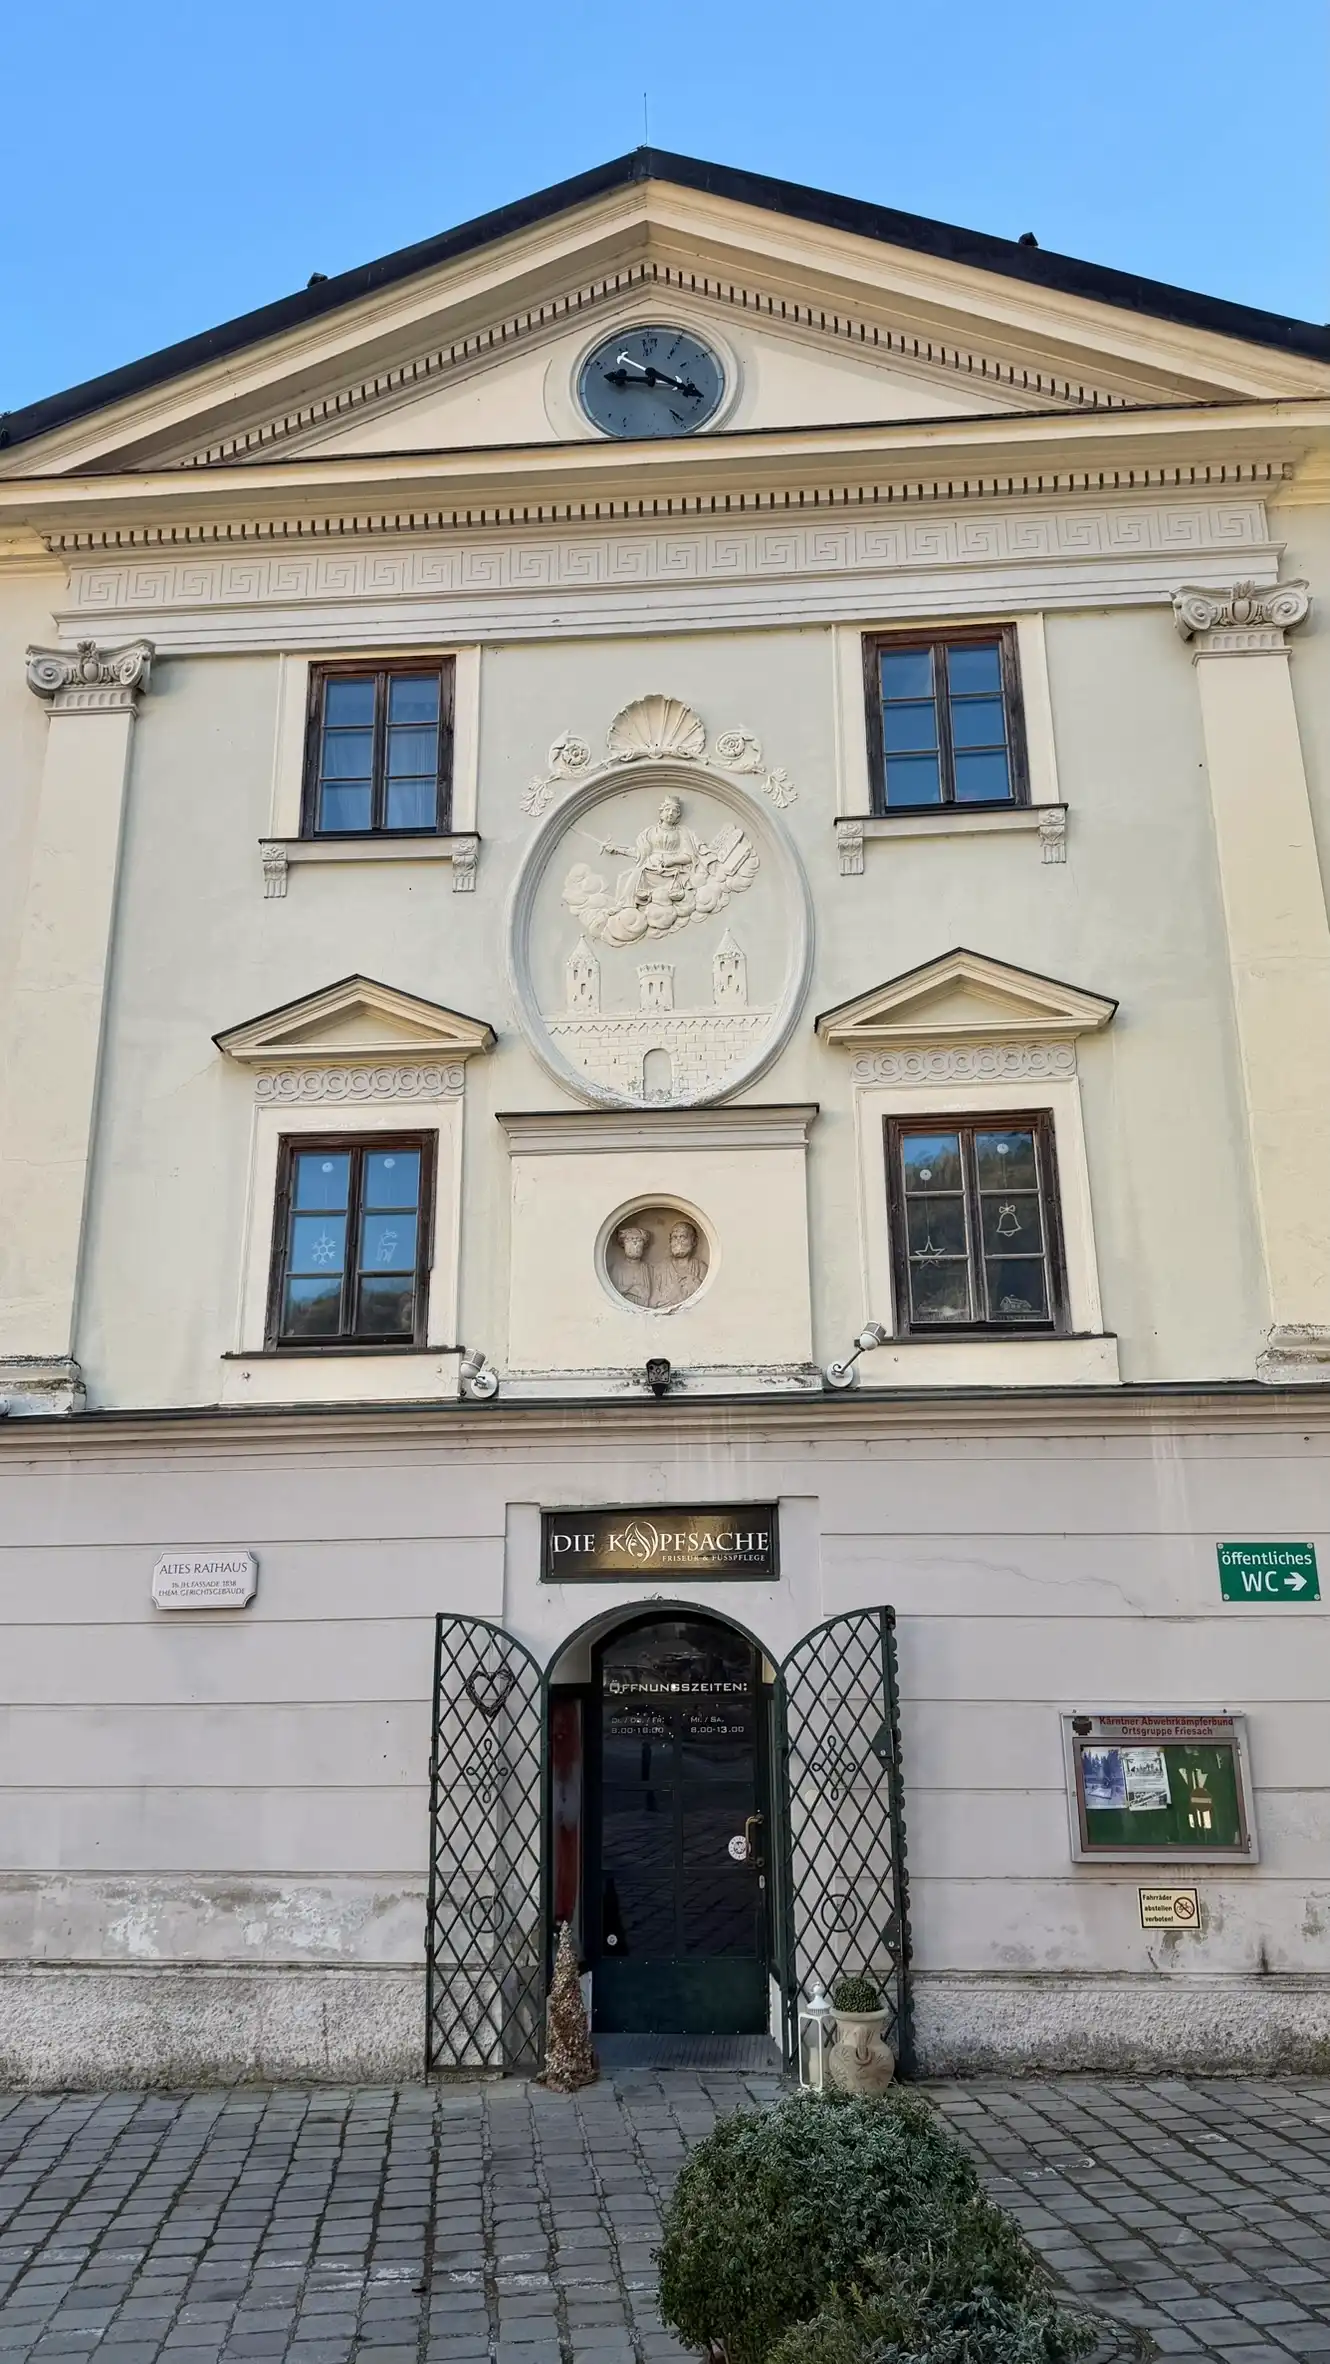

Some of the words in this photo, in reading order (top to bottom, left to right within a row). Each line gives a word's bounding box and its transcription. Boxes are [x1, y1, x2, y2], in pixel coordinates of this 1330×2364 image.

[553, 1534, 595, 1553] DIE
[1221, 1551, 1312, 1565] öffentliches
[159, 1563, 191, 1575] ALTES
[193, 1562, 248, 1574] RATHAUS
[1241, 1571, 1279, 1592] WC
[609, 1680, 748, 1693] ÖFFNUNGSZEITEN:
[1099, 1716, 1138, 1725] Kärntner
[1121, 1727, 1173, 1736] Ortsgruppe
[1175, 1726, 1213, 1735] Friesach
[1145, 1915, 1174, 1923] verboten!
